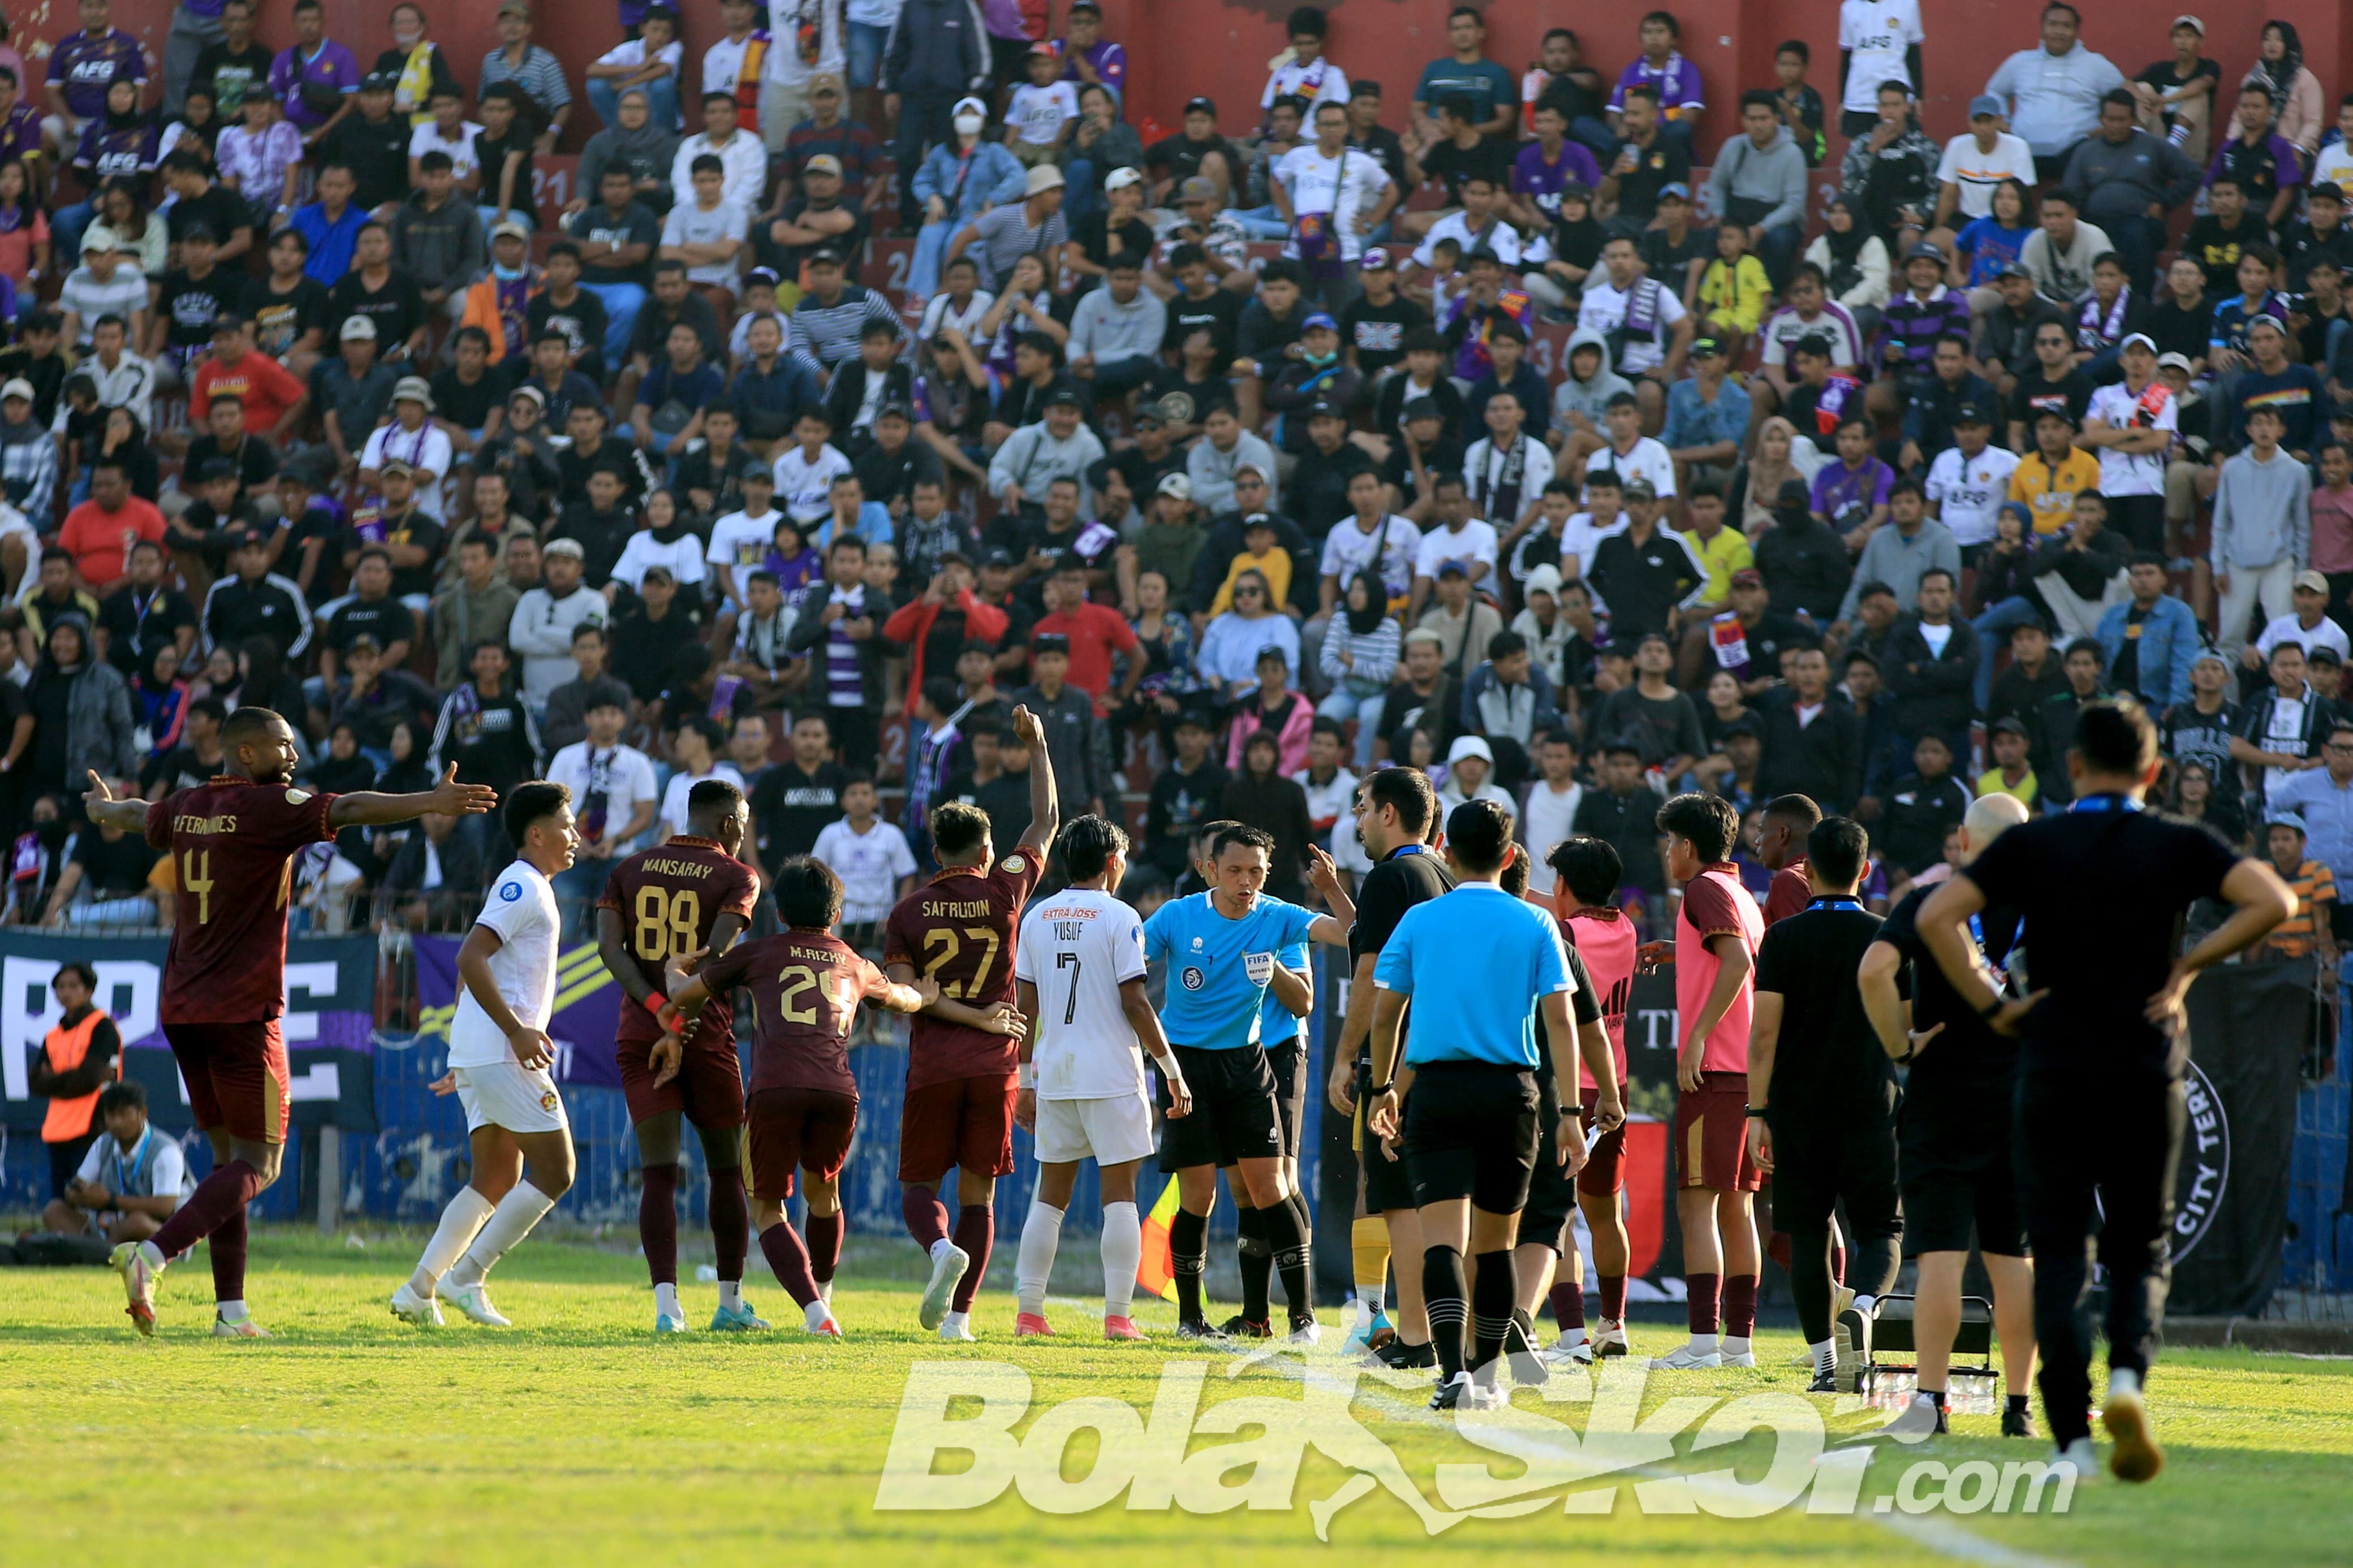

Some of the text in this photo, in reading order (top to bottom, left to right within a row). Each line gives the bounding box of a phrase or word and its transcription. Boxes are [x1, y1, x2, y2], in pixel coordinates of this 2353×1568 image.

[884, 724, 904, 764] 2
[184, 848, 214, 924] 4
[641, 858, 713, 879] MANSARAY
[635, 885, 699, 961] 88
[922, 899, 990, 918] SAFRUDIN
[1042, 909, 1098, 919] EXTRA JOSS
[1054, 922, 1083, 941] YUSUF
[790, 945, 847, 966] M.RIZKY
[924, 927, 999, 999] 27
[1247, 955, 1269, 965] FIFA
[778, 965, 853, 1037] 24
[1057, 952, 1081, 1025] 7
[2175, 1161, 2218, 1236] CITY
